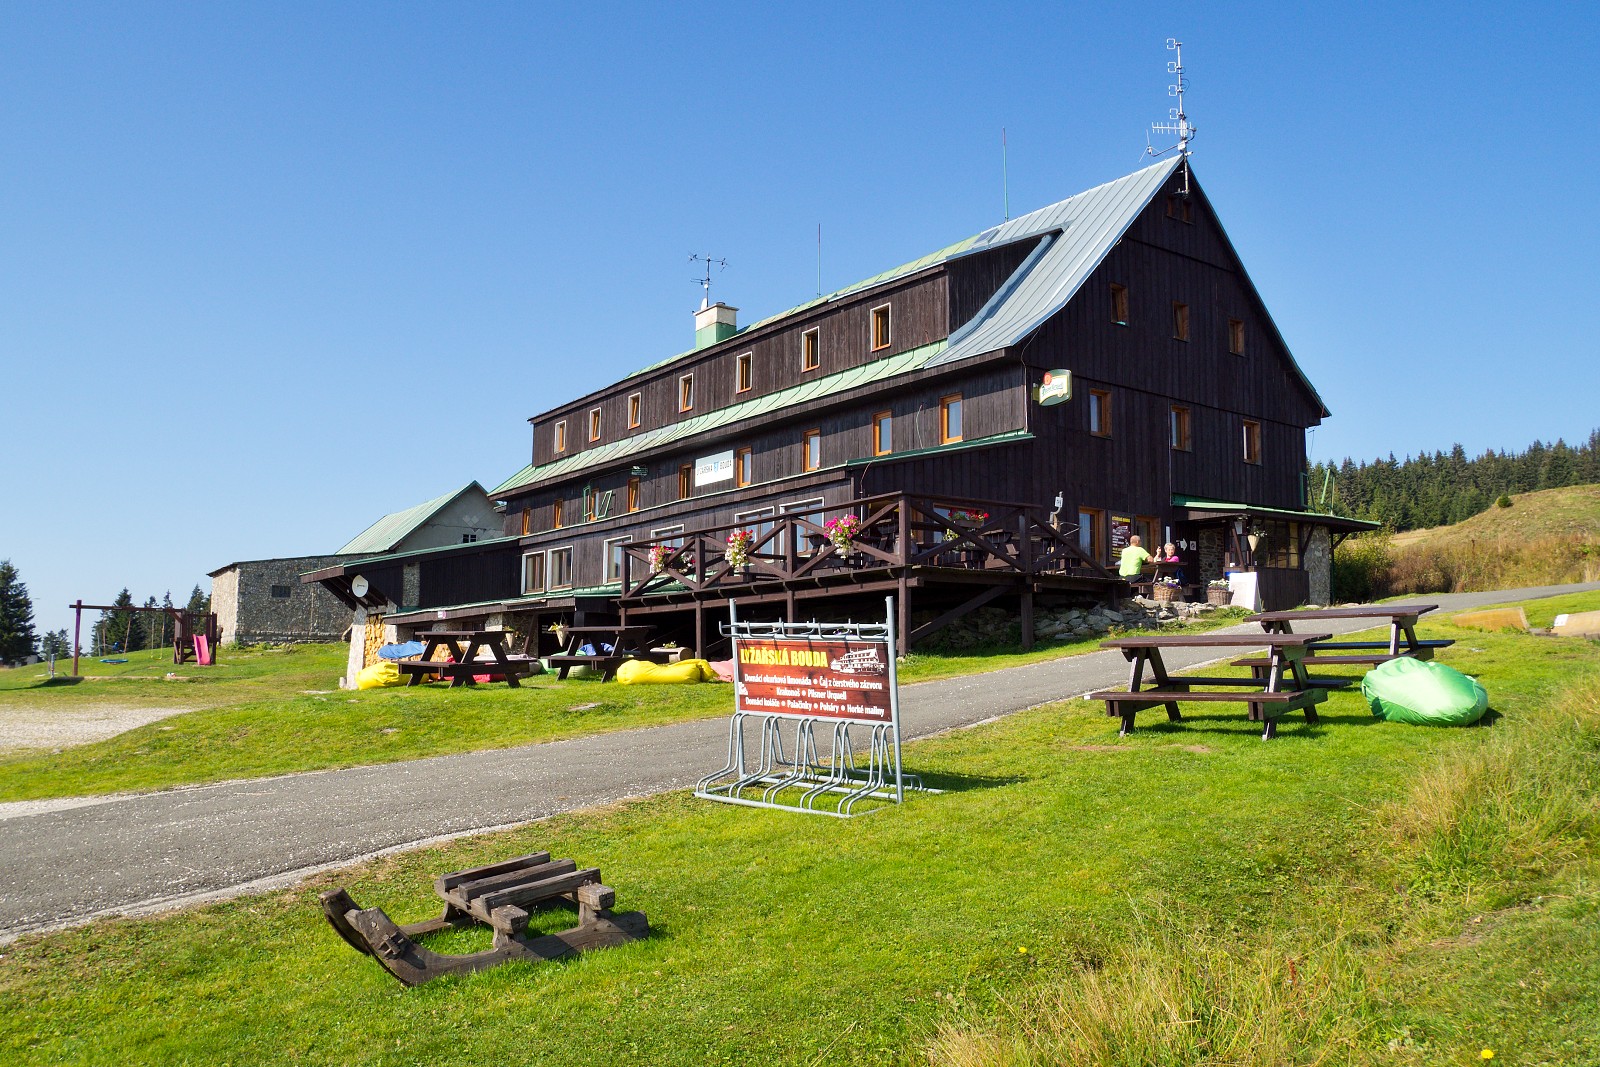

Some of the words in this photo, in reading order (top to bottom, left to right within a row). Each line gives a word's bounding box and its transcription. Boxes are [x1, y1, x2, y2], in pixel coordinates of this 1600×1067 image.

[740, 647, 790, 666] LYŽAŘSKÁ
[790, 650, 829, 667] BOUDA
[786, 676, 812, 685] limonáda
[819, 676, 828, 688] Čaj
[832, 678, 859, 688] čerstvého
[860, 680, 882, 690] zázvoru
[776, 687, 801, 697] Krakonoš
[807, 688, 826, 699] Pilsner
[826, 690, 847, 701] Urquell
[745, 696, 763, 706] Domácí
[787, 699, 812, 711] Palačinky
[820, 702, 840, 713] Poháry
[847, 704, 864, 714] Horké
[864, 706, 885, 717] maliny
